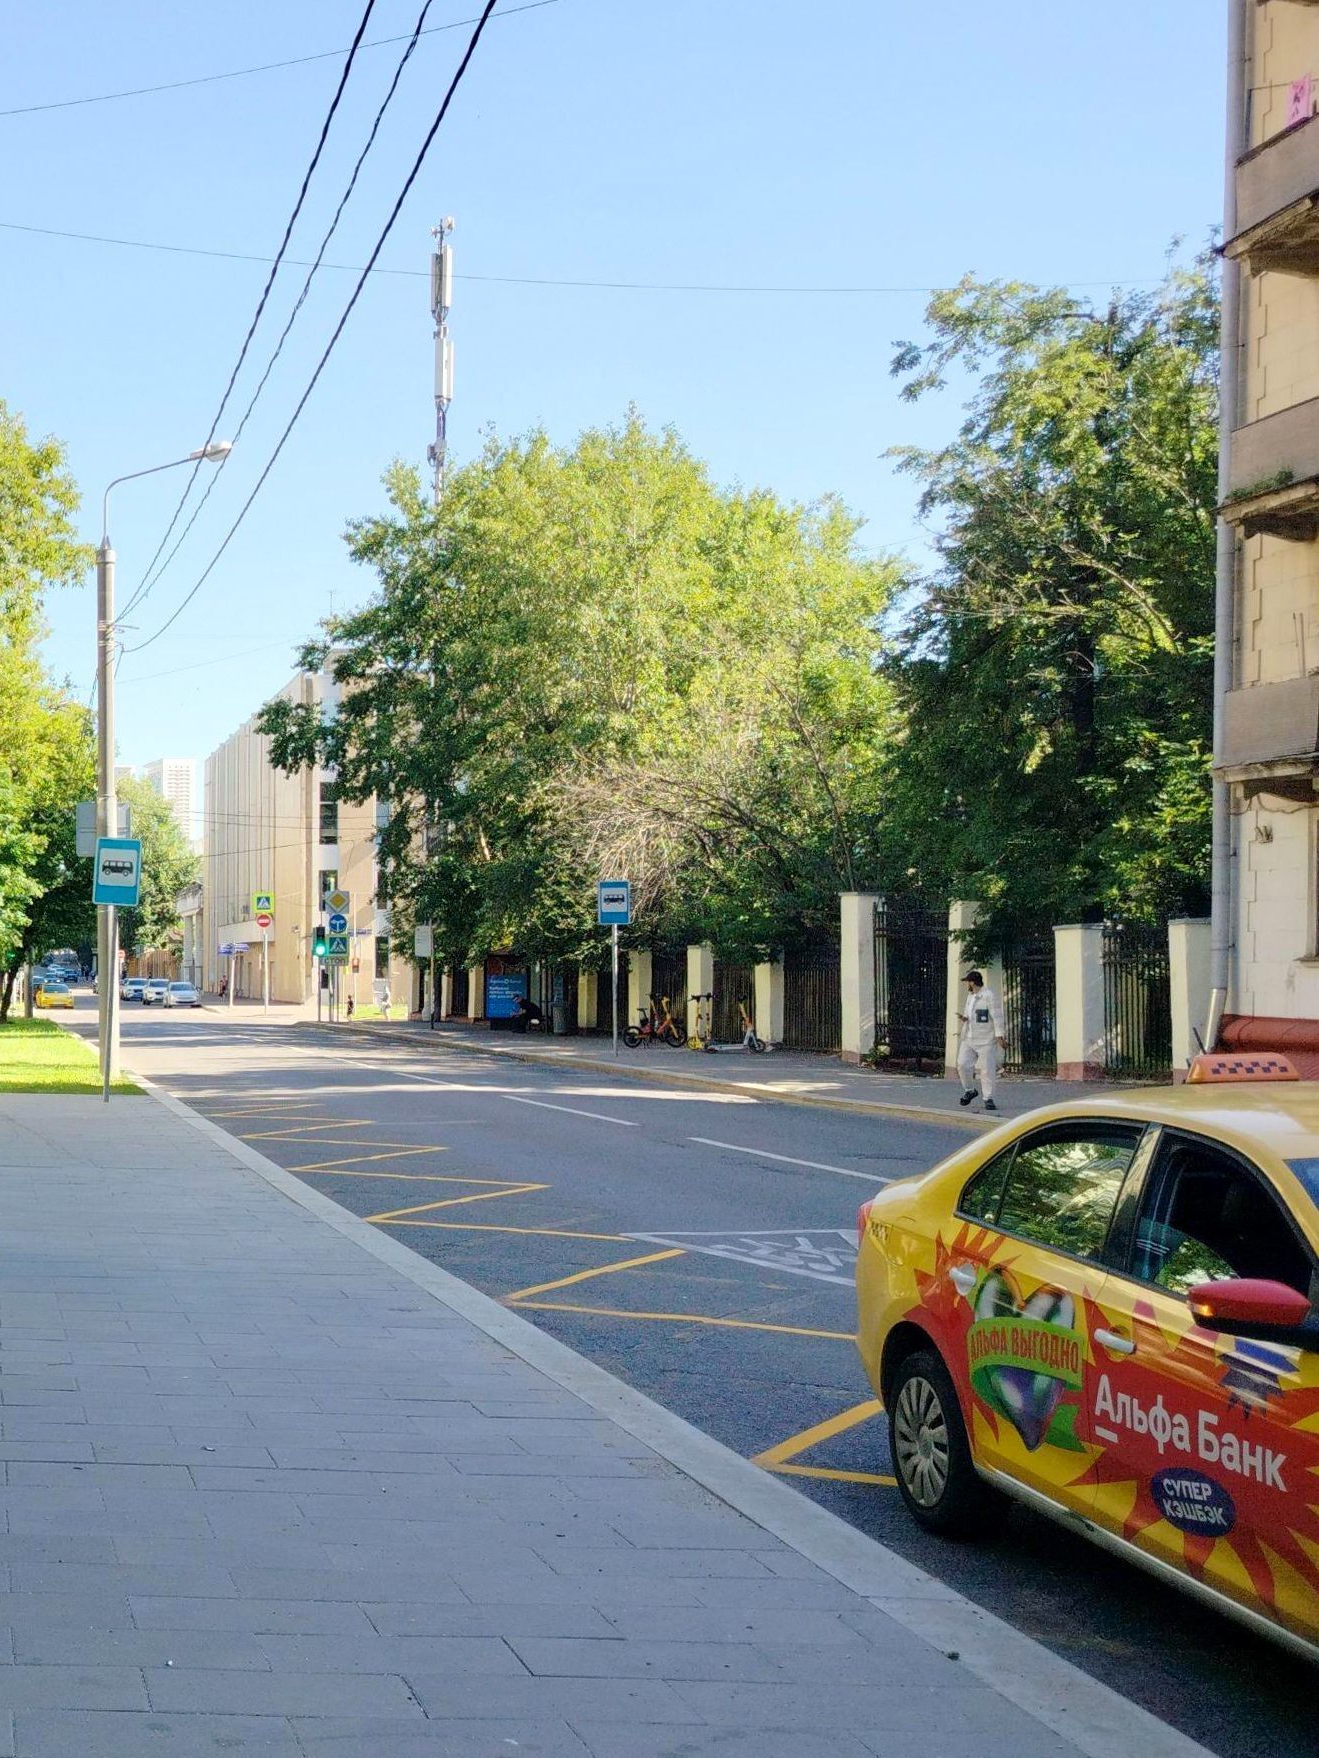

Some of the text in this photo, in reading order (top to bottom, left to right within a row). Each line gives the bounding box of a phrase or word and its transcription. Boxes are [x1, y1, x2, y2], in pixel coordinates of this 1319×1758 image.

[970, 1326, 1079, 1374] АЛЬФА ВЫГОДНО
[1094, 1374, 1288, 1492] Альфа Банк
[1162, 1477, 1213, 1501] СУПЕР
[1162, 1498, 1228, 1526] КЭШБЭК
